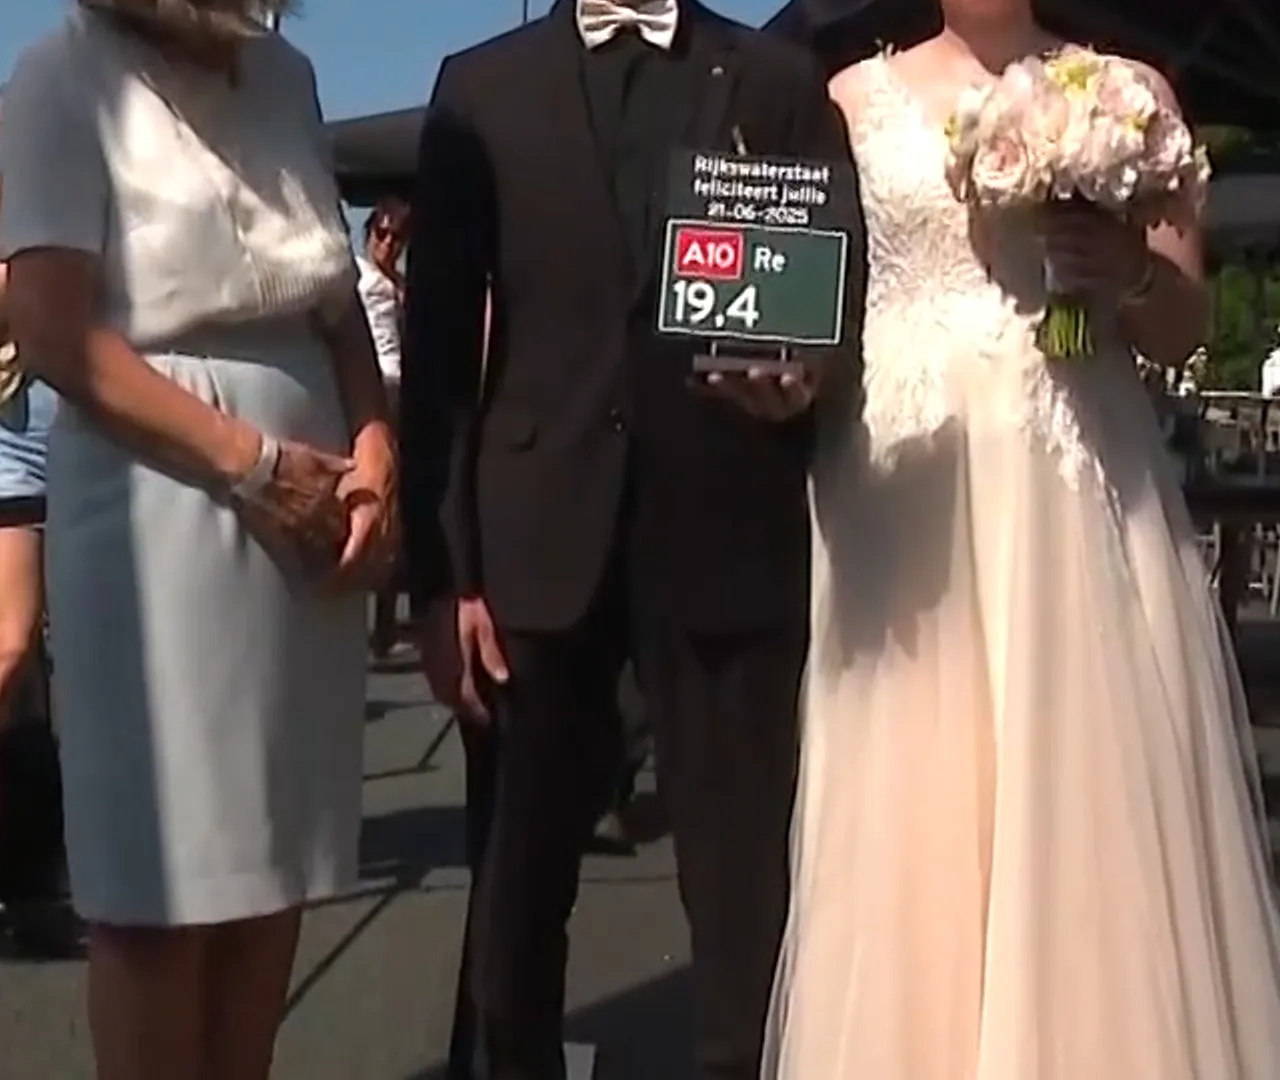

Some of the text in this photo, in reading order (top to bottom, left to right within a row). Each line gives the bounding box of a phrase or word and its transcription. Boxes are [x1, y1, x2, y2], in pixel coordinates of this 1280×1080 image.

[694, 155, 829, 184] Rijkswaterstaat
[694, 179, 826, 205] feliciteert jullie
[682, 242, 787, 272] A10 Re
[673, 280, 759, 328] 19,4
